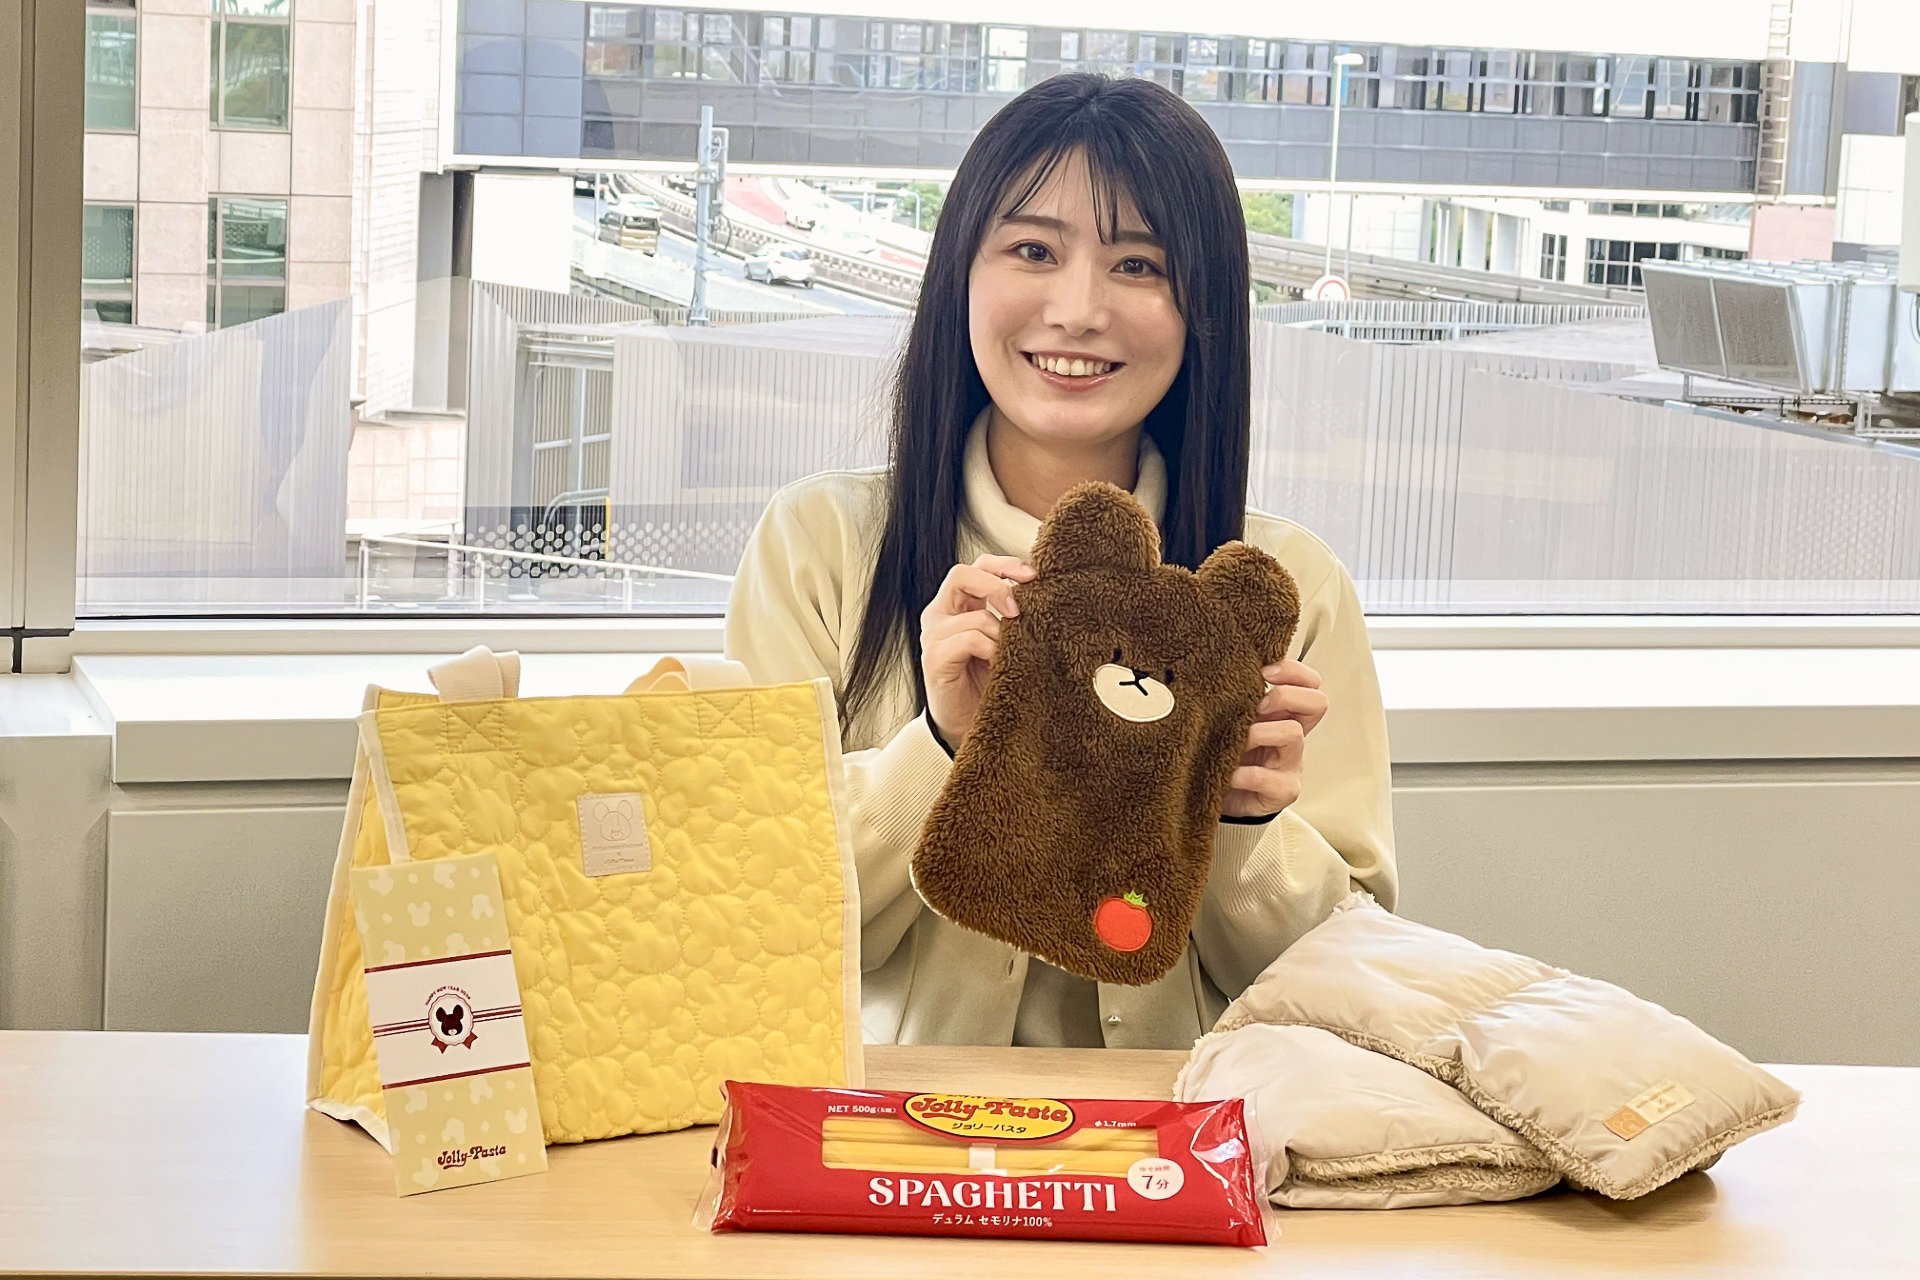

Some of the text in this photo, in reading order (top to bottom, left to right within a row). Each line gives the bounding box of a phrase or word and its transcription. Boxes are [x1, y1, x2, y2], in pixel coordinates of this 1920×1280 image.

[827, 1105, 850, 1113] NET
[951, 1122, 1027, 1134] ジョリーパスタ
[868, 1177, 1117, 1212] SPAGHETTI
[932, 1212, 974, 1225] デュラム
